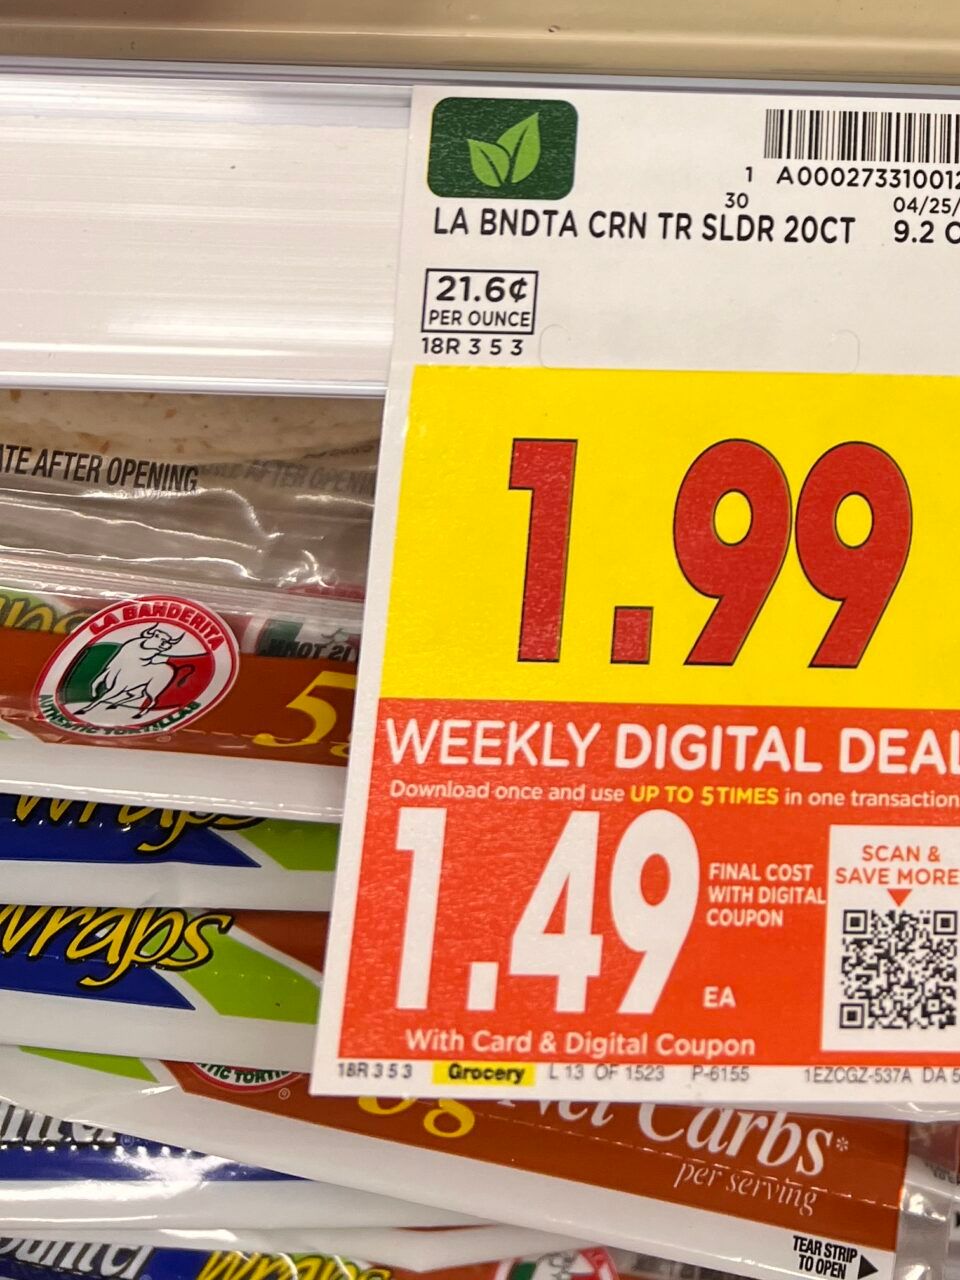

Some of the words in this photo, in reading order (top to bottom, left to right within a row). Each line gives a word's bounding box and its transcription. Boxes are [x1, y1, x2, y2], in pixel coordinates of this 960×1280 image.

[724, 192, 749, 209] 30
[433, 207, 466, 235] LA
[479, 208, 579, 237] BNDTA
[588, 211, 647, 239] CRN
[657, 213, 693, 240] TR
[701, 214, 775, 242] SLDR
[783, 216, 856, 244] 20CT
[893, 220, 935, 244] 9.2
[436, 275, 529, 304] 21.6¢
[428, 309, 463, 326] PER
[467, 310, 531, 328] OUNCE
[421, 337, 461, 356] 18R
[467, 338, 481, 356] 3
[490, 339, 503, 356] 5
[510, 339, 524, 357] 3
[0, 443, 32, 475] TE
[32, 447, 104, 484] AFTER
[106, 456, 200, 492] OPENING
[507, 437, 913, 670] 1.99
[88, 612, 121, 636] LA
[122, 600, 226, 652] BANDERITA
[384, 718, 601, 768] WEEKLY
[615, 722, 825, 773] DIGITAL
[389, 779, 491, 800] Download
[493, 786, 543, 800] once
[548, 783, 586, 802] and
[590, 787, 626, 802] use
[630, 785, 660, 803] UP
[663, 786, 694, 804] TO
[700, 786, 715, 806] 5
[717, 786, 779, 806] TIMES
[784, 788, 803, 806] in
[808, 790, 846, 806] one
[861, 844, 921, 863] SCAN
[927, 845, 941, 863] &
[708, 862, 761, 881] FINAL
[766, 863, 814, 882] COST
[835, 867, 890, 885] SAVE
[708, 885, 754, 904] WITH
[757, 886, 827, 905] DIGITAL
[393, 807, 702, 1016] 1.49
[706, 907, 784, 927] COUPON
[702, 986, 737, 1008] EA
[405, 1027, 468, 1052] With
[472, 1029, 534, 1054] Card
[540, 1032, 558, 1055] &
[563, 1031, 648, 1060] Digital
[655, 1033, 756, 1059] Coupon
[337, 1062, 368, 1078] 18R
[373, 1063, 383, 1078] 3
[388, 1063, 399, 1079] 5
[402, 1064, 414, 1079] 3
[447, 1062, 526, 1084] Grocery
[549, 1063, 558, 1080] L
[565, 1064, 584, 1081] 13
[593, 1064, 617, 1081] OF
[625, 1065, 665, 1082] 1523
[692, 1065, 750, 1082] P-6155
[922, 1067, 947, 1084] DA
[673, 1157, 721, 1189] per
[725, 1169, 818, 1216] serving
[793, 1234, 823, 1257] TEAR
[824, 1242, 858, 1263] STRIP
[798, 1254, 814, 1272] TO
[815, 1258, 848, 1280] OPEN
